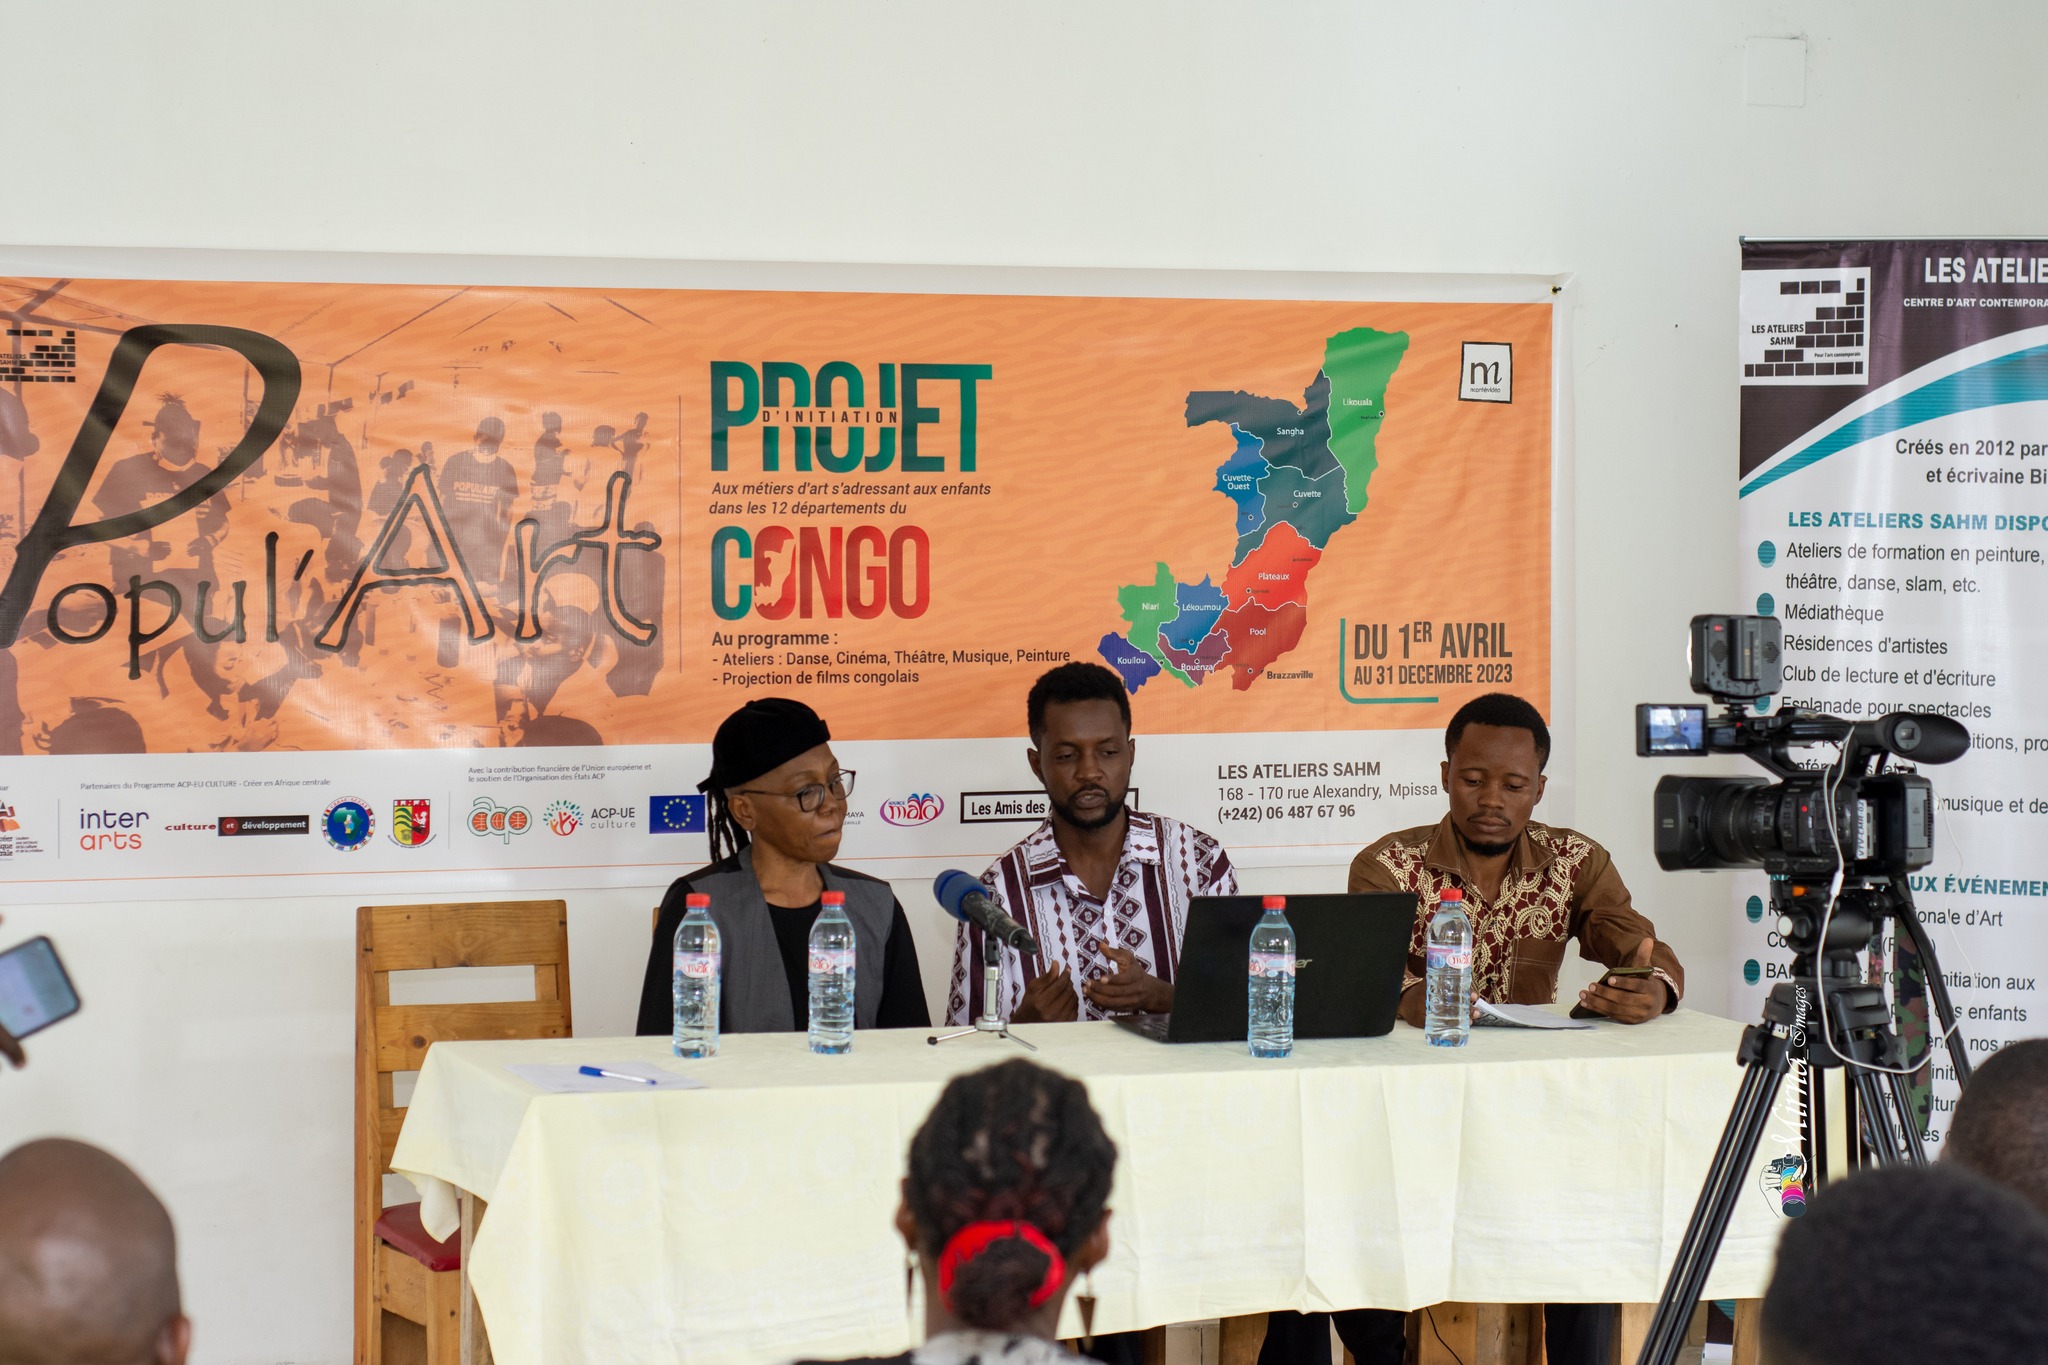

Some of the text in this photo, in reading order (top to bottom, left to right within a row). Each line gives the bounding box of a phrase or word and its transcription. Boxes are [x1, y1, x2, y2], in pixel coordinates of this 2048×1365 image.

[1924, 257, 2048, 283] LES ATELIE
[1903, 298, 1944, 308] CENTRE
[1946, 298, 1977, 308] D'ART
[1751, 324, 1804, 334] LES ATELIERS
[1770, 336, 1795, 346] SAHM
[1342, 397, 1373, 407] Likouala
[710, 361, 993, 473] PROJET
[762, 410, 898, 424] D'INITIATION
[1276, 427, 1304, 437] Sangha
[1895, 438, 2048, 460] Créés en 2012 par
[1222, 473, 1255, 482] Cuvette-
[1926, 468, 1942, 483] et
[1946, 467, 2026, 484] écrivaine
[712, 481, 991, 496] Aux métiers d'art s'adressant aux enfants
[1227, 482, 1250, 490] Ouest
[1293, 490, 1322, 498] Cuvette
[708, 501, 907, 517] dans les 12 départements du
[1788, 511, 1823, 528] LES
[1828, 511, 1924, 529] ATELIERS
[1929, 513, 1988, 530] SAHM
[1786, 542, 2046, 566] Ateliers de formation en peinture,
[710, 524, 930, 621] CONGO
[1257, 572, 1290, 581] Plateaux
[1785, 573, 1981, 594] théâtre, danse, slam, etc.
[1141, 602, 1160, 611] Niari
[1182, 603, 1221, 611] Lékoumou
[1784, 603, 1884, 624] Médiathèque
[1249, 627, 1267, 636] Pool
[712, 631, 830, 649] Au programme
[1354, 624, 1388, 660] DU
[1439, 622, 1513, 659] AVRIL
[1783, 634, 1949, 655] Résidences d'artistes
[722, 648, 1071, 667] Ateliers Danse, Cinéma, Théâtre, Musique, Peinture
[1181, 663, 1213, 671] Bouenza
[1266, 670, 1314, 680] Brazzaville
[1353, 663, 1513, 685] AU 31 DECEMBRE 2023
[722, 670, 920, 688] Projection de films congolais
[1782, 664, 1997, 687] Club de lecture et d'écriture
[1867, 701, 1904, 717] pour
[493, 765, 536, 773] contribution
[537, 765, 570, 773] financière
[645, 763, 652, 771] et
[1217, 761, 1381, 780] LES ATELIERS SAHM
[80, 782, 121, 790] Partenaires
[133, 781, 175, 790] Programme
[205, 780, 237, 788] CULTURE
[243, 779, 262, 787] Créer
[275, 779, 301, 788] Afrique
[302, 778, 331, 786] centrale
[476, 775, 501, 783] soutien
[503, 774, 512, 782] de
[560, 773, 573, 781] des
[1218, 782, 1438, 801] 168 170 rue Alexandry, Mpissa
[590, 807, 636, 819] ACP-UE
[971, 799, 1045, 815] Les Amis des
[2009, 797, 2024, 814] et
[80, 808, 149, 829] inter
[1217, 804, 1356, 824] (+242) 06 487 67 96
[164, 823, 217, 831] culture
[241, 820, 306, 830] développement
[590, 819, 636, 829] culture
[79, 831, 142, 851] arts
[2006, 977, 2036, 991] aux
[1968, 1004, 2028, 1022] enfants
[1970, 1037, 1999, 1052] nos
